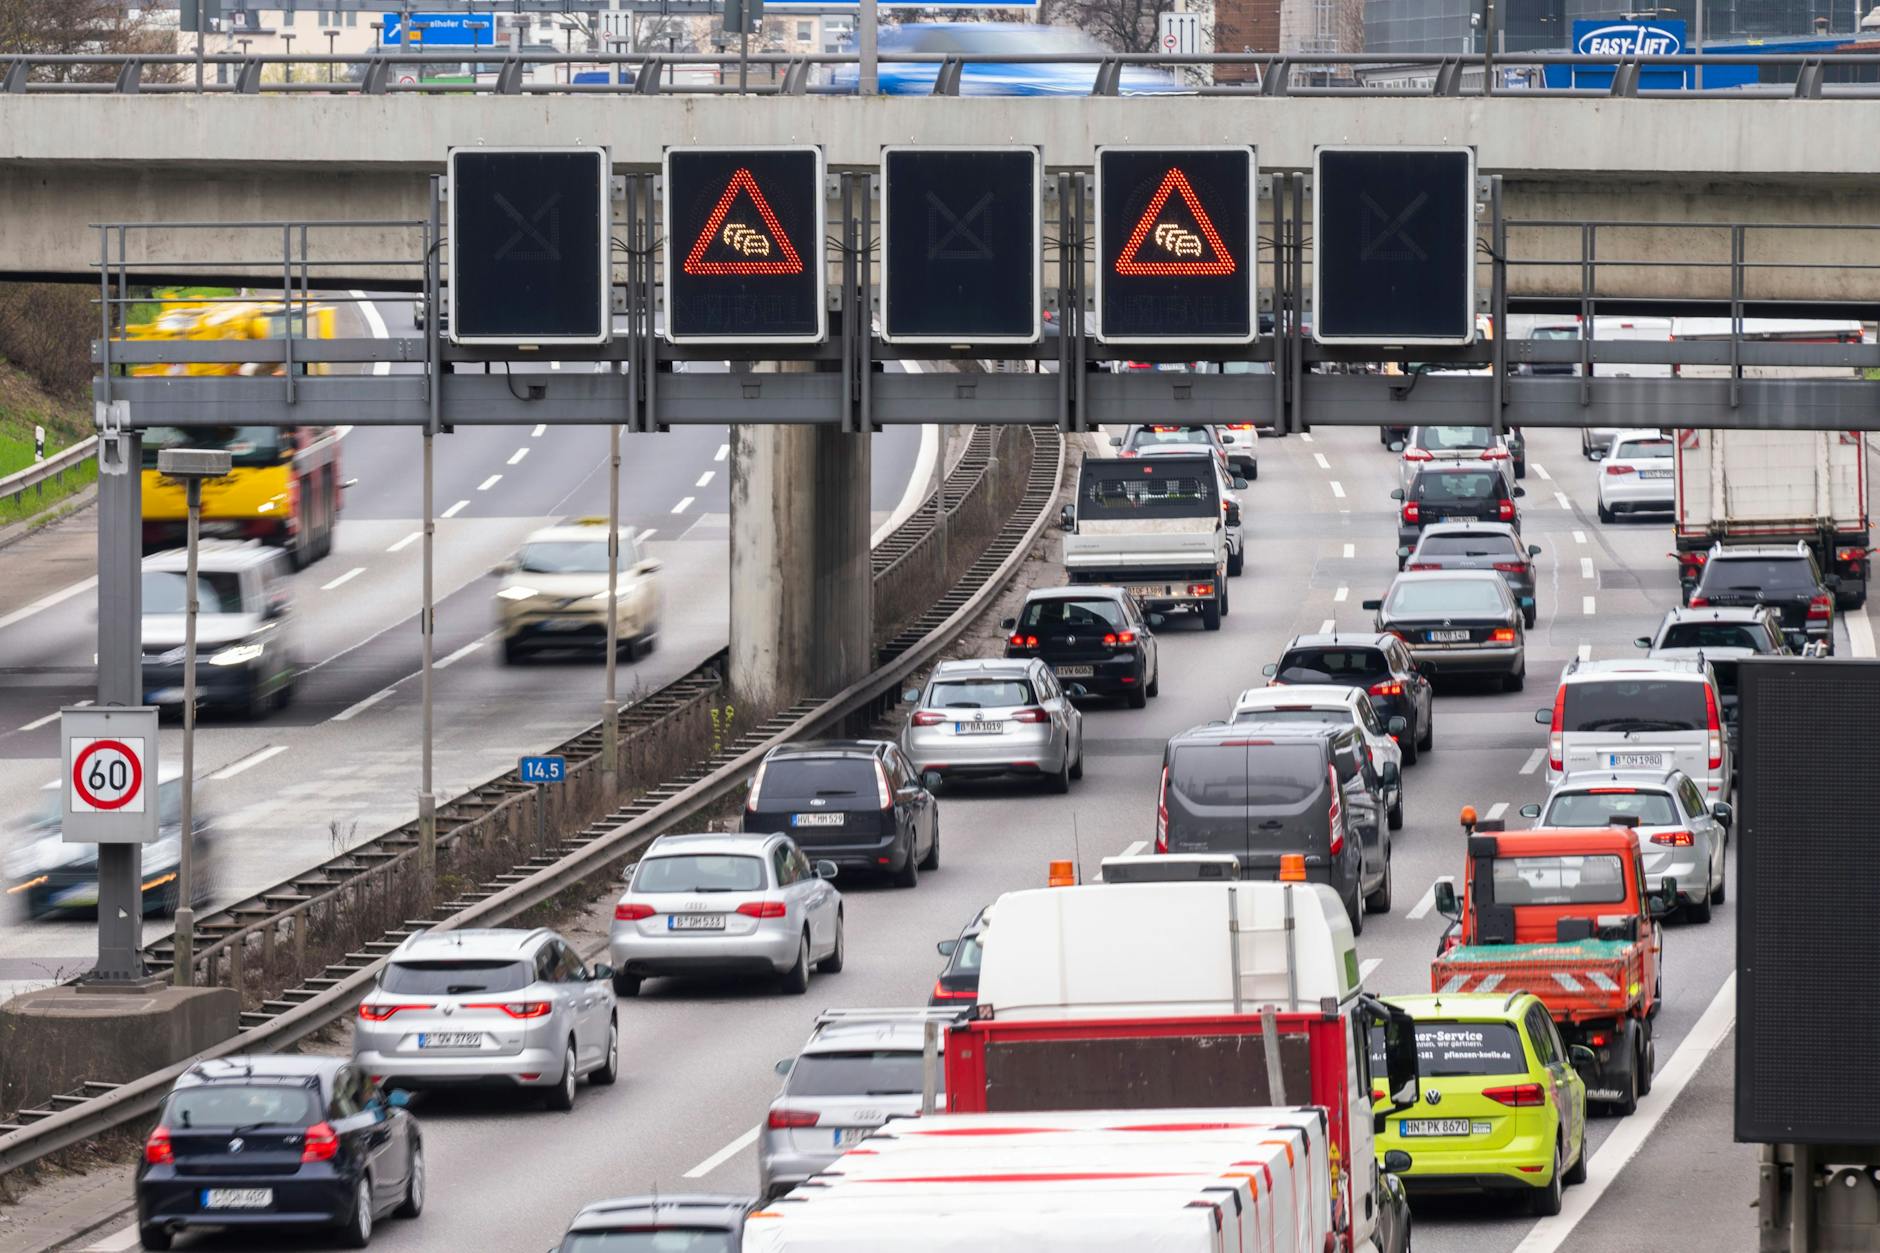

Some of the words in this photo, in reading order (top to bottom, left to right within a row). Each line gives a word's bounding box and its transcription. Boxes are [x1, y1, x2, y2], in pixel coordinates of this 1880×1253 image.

[1590, 30, 1670, 55] EASY-LIFT
[88, 759, 127, 791] 60
[527, 761, 560, 779] 14.5
[1407, 1121, 1421, 1133] HN
[1427, 1121, 1441, 1132] PK
[1442, 1120, 1468, 1132] 8670
